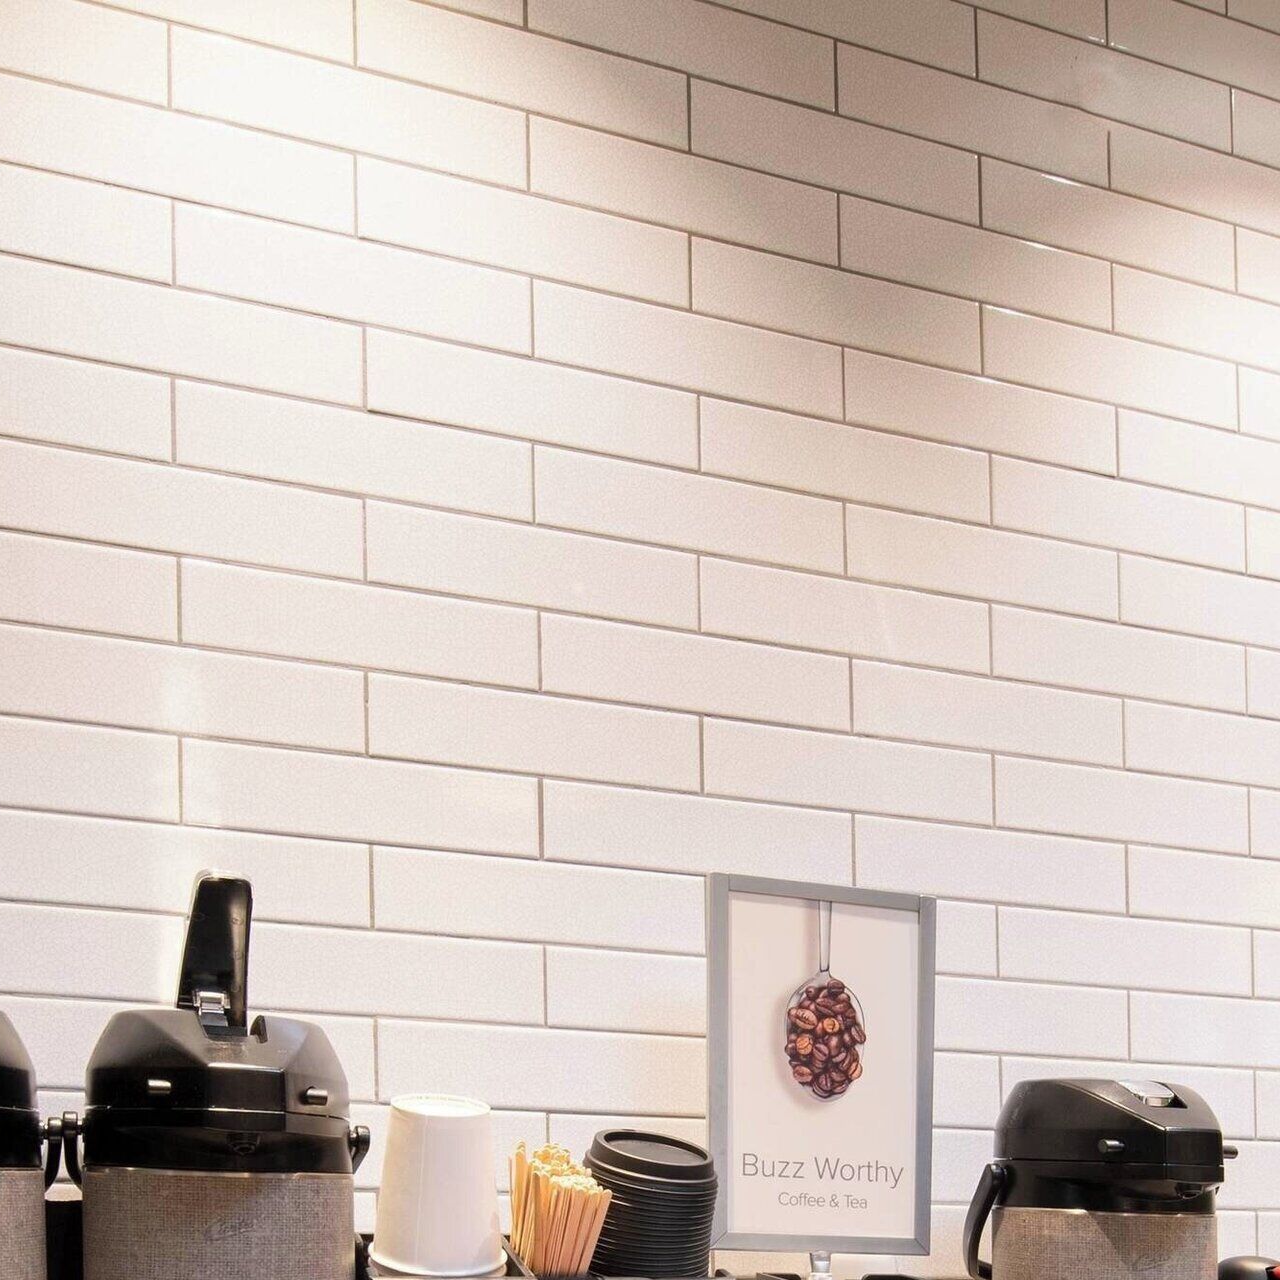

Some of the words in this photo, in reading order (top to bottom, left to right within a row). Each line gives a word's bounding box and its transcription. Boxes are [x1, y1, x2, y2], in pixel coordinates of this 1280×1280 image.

[742, 1152, 805, 1179] Buzz
[814, 1156, 904, 1190] Worthy
[778, 1191, 826, 1207] Coffee
[829, 1194, 840, 1208] &
[844, 1194, 868, 1209] Tea
